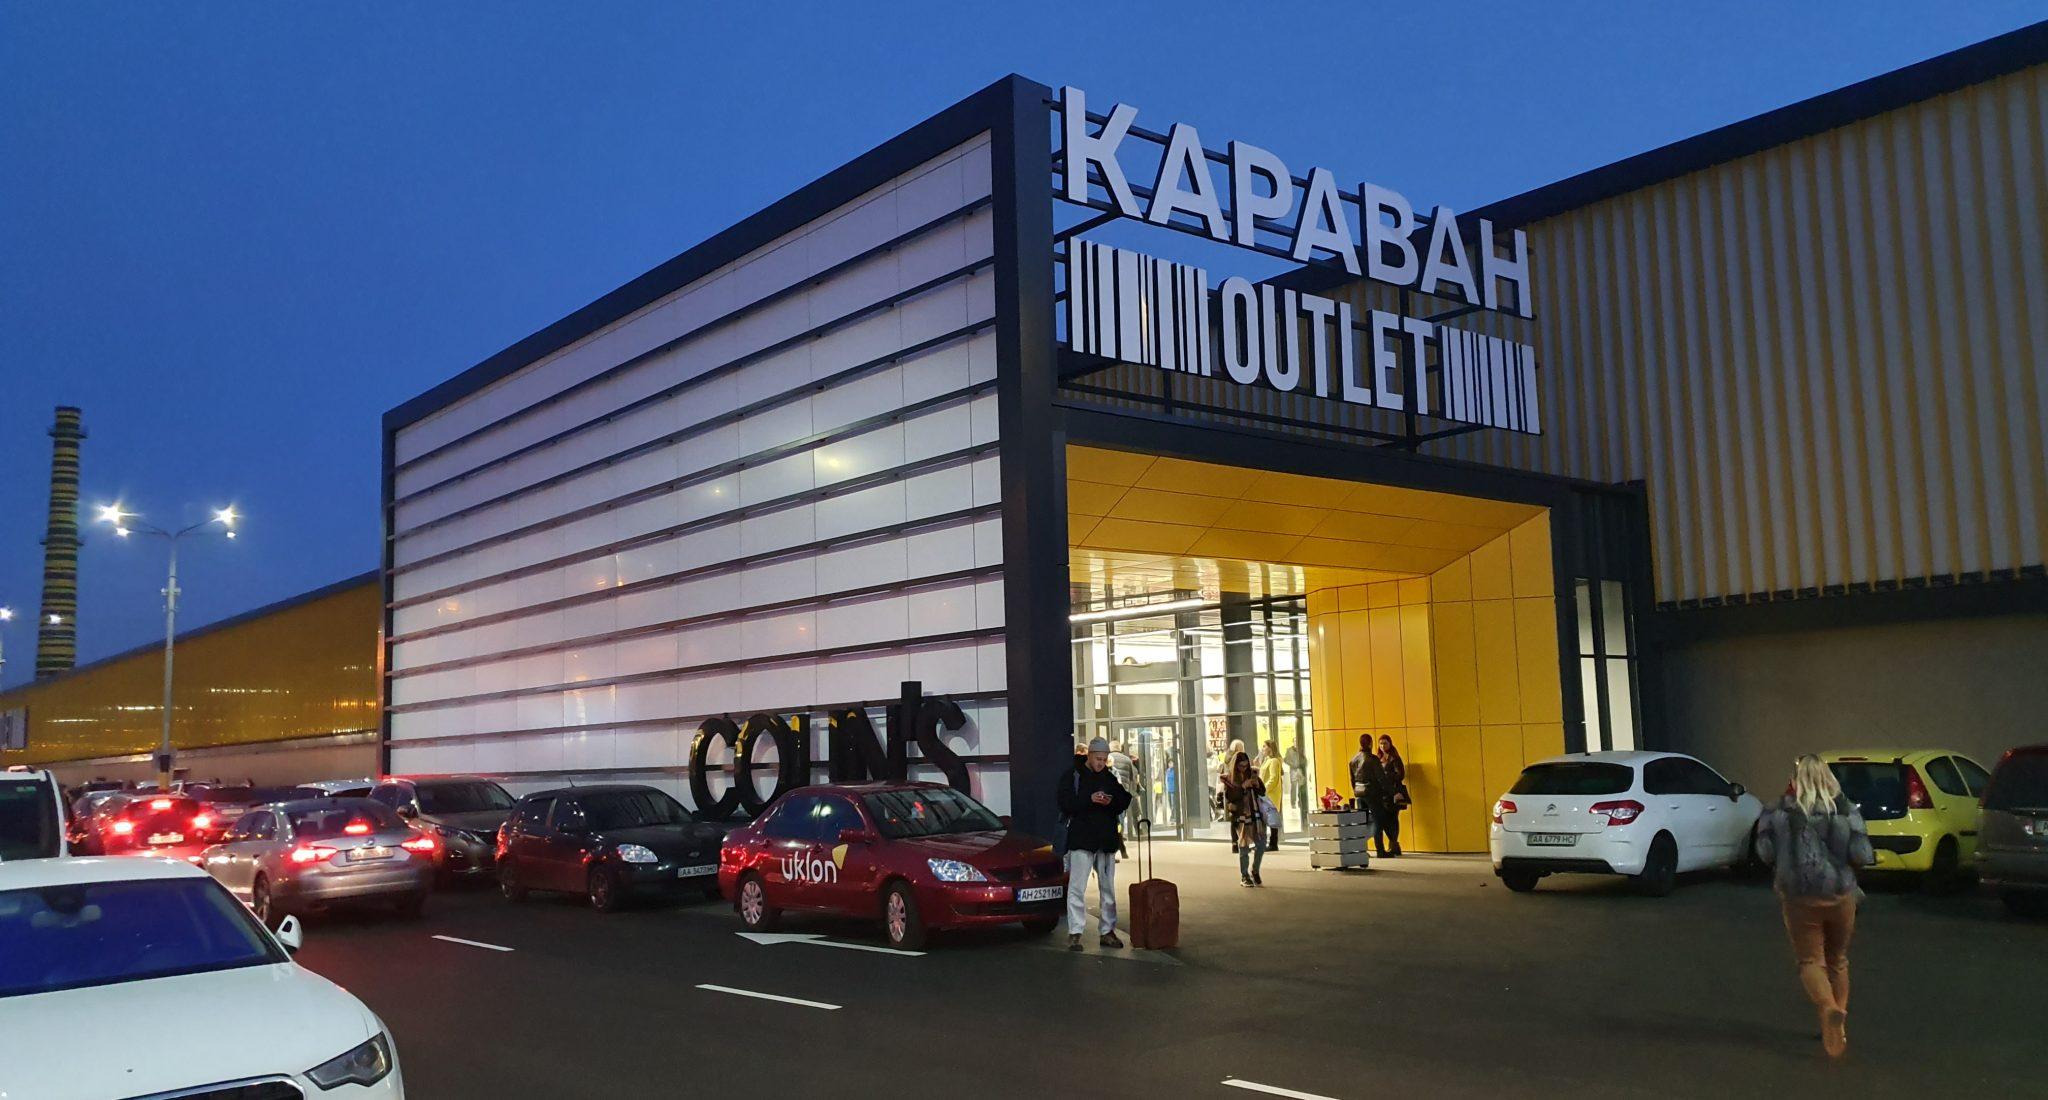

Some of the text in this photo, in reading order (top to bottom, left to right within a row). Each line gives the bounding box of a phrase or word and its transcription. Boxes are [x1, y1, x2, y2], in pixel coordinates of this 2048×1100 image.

[1060, 85, 1533, 319] КАРАВАН
[1219, 275, 1434, 415] OUTLET
[781, 850, 837, 884] uklon
